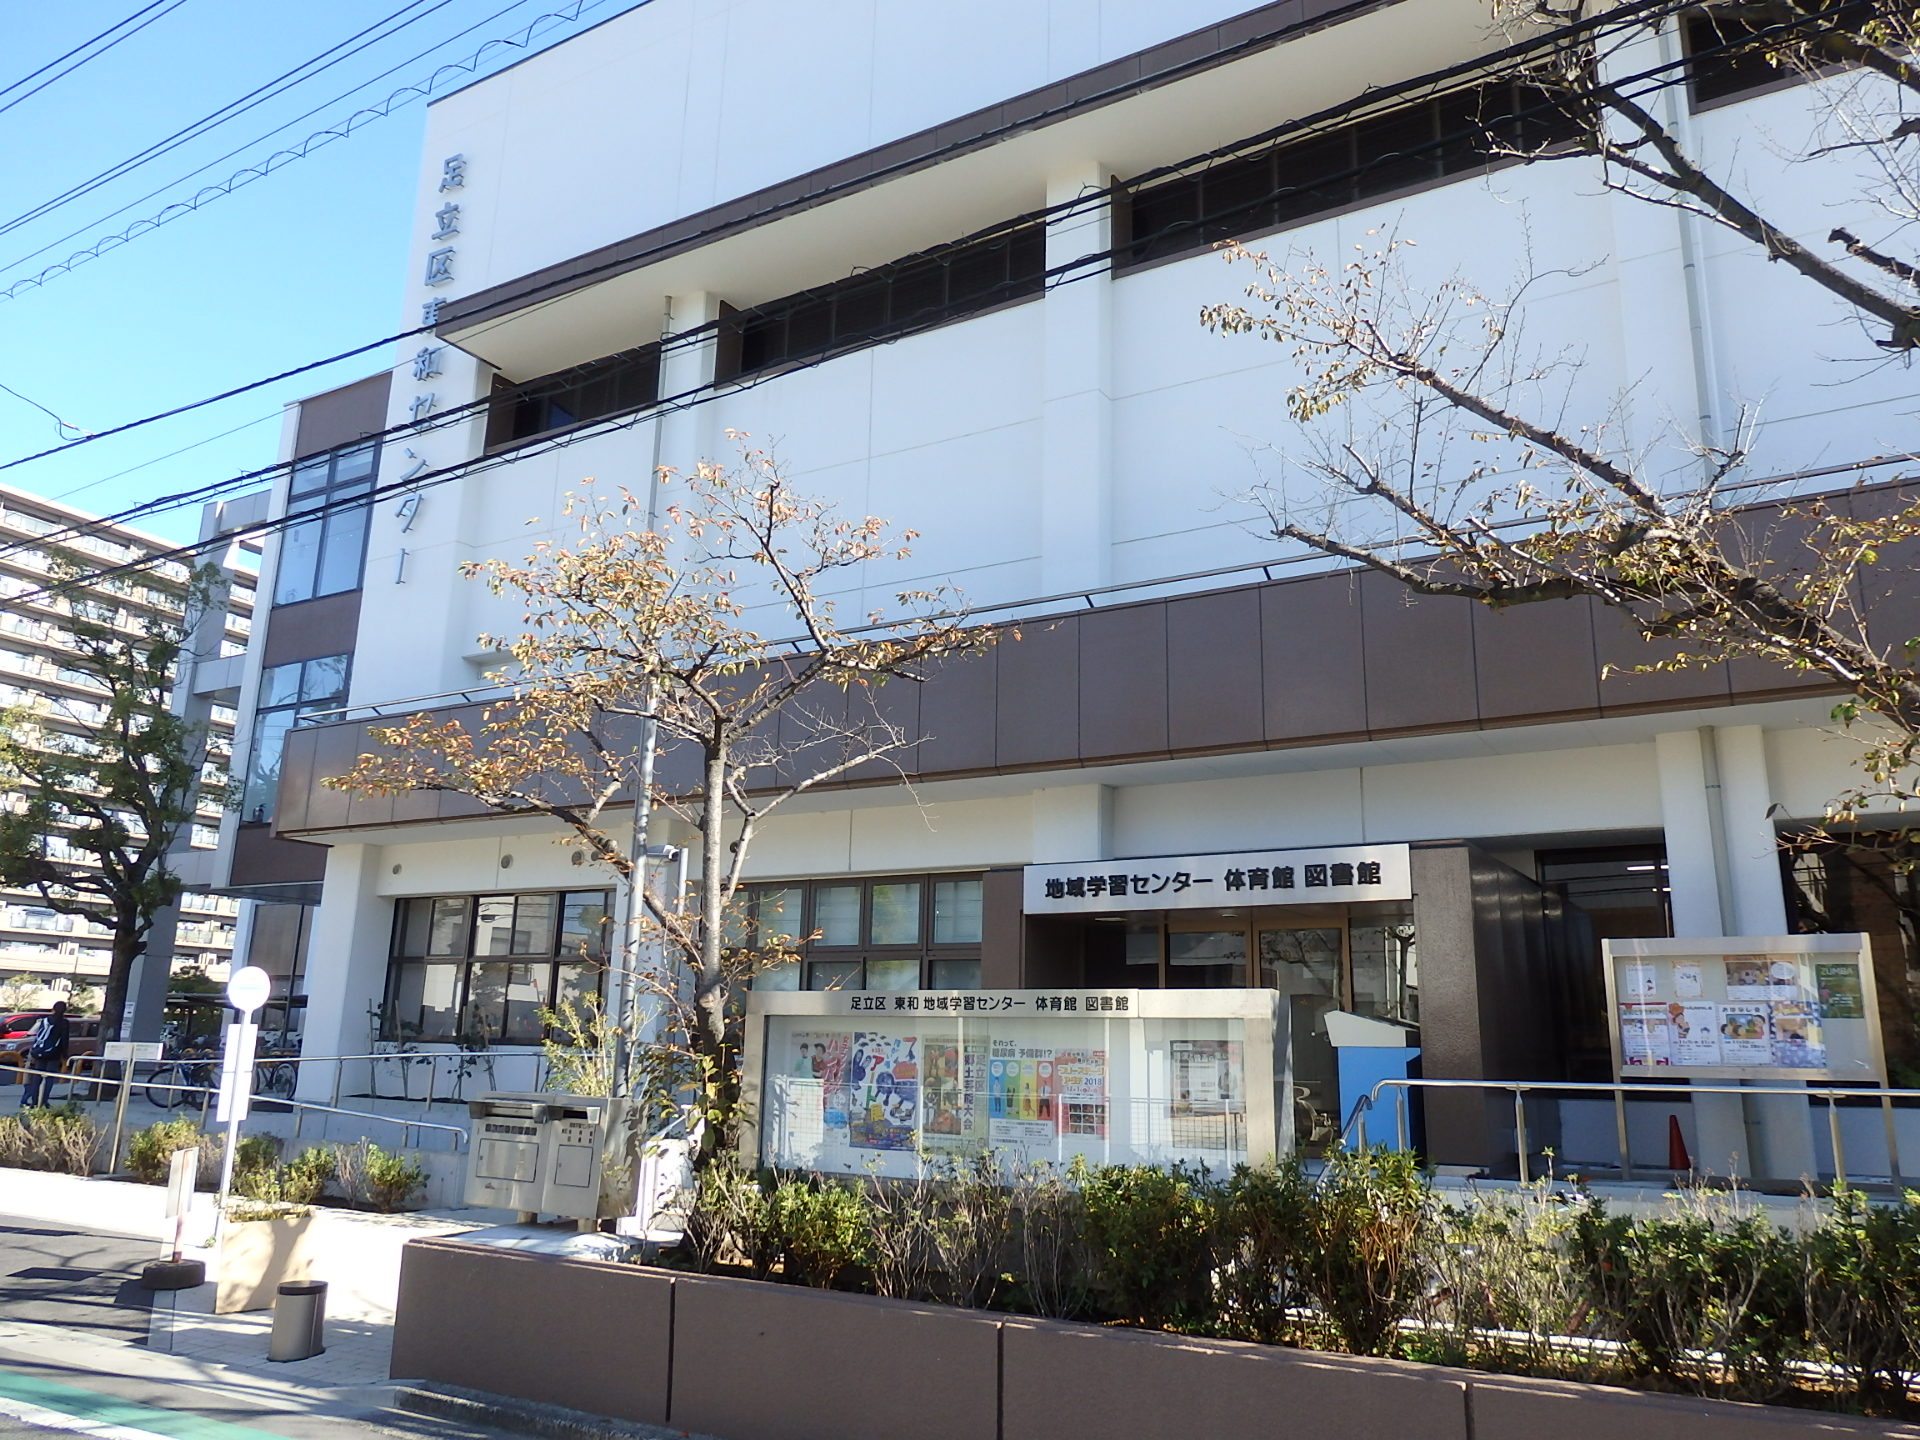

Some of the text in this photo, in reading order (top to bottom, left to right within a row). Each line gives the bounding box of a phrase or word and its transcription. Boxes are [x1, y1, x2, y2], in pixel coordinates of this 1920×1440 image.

[1045, 861, 1382, 899] 地域学習センター 体育館 図書館
[850, 996, 1129, 1012] 足立区 東和 地域学習センター 体育館 図書館
[974, 1053, 987, 1092] 足立区
[1084, 1077, 1103, 1086] 2018
